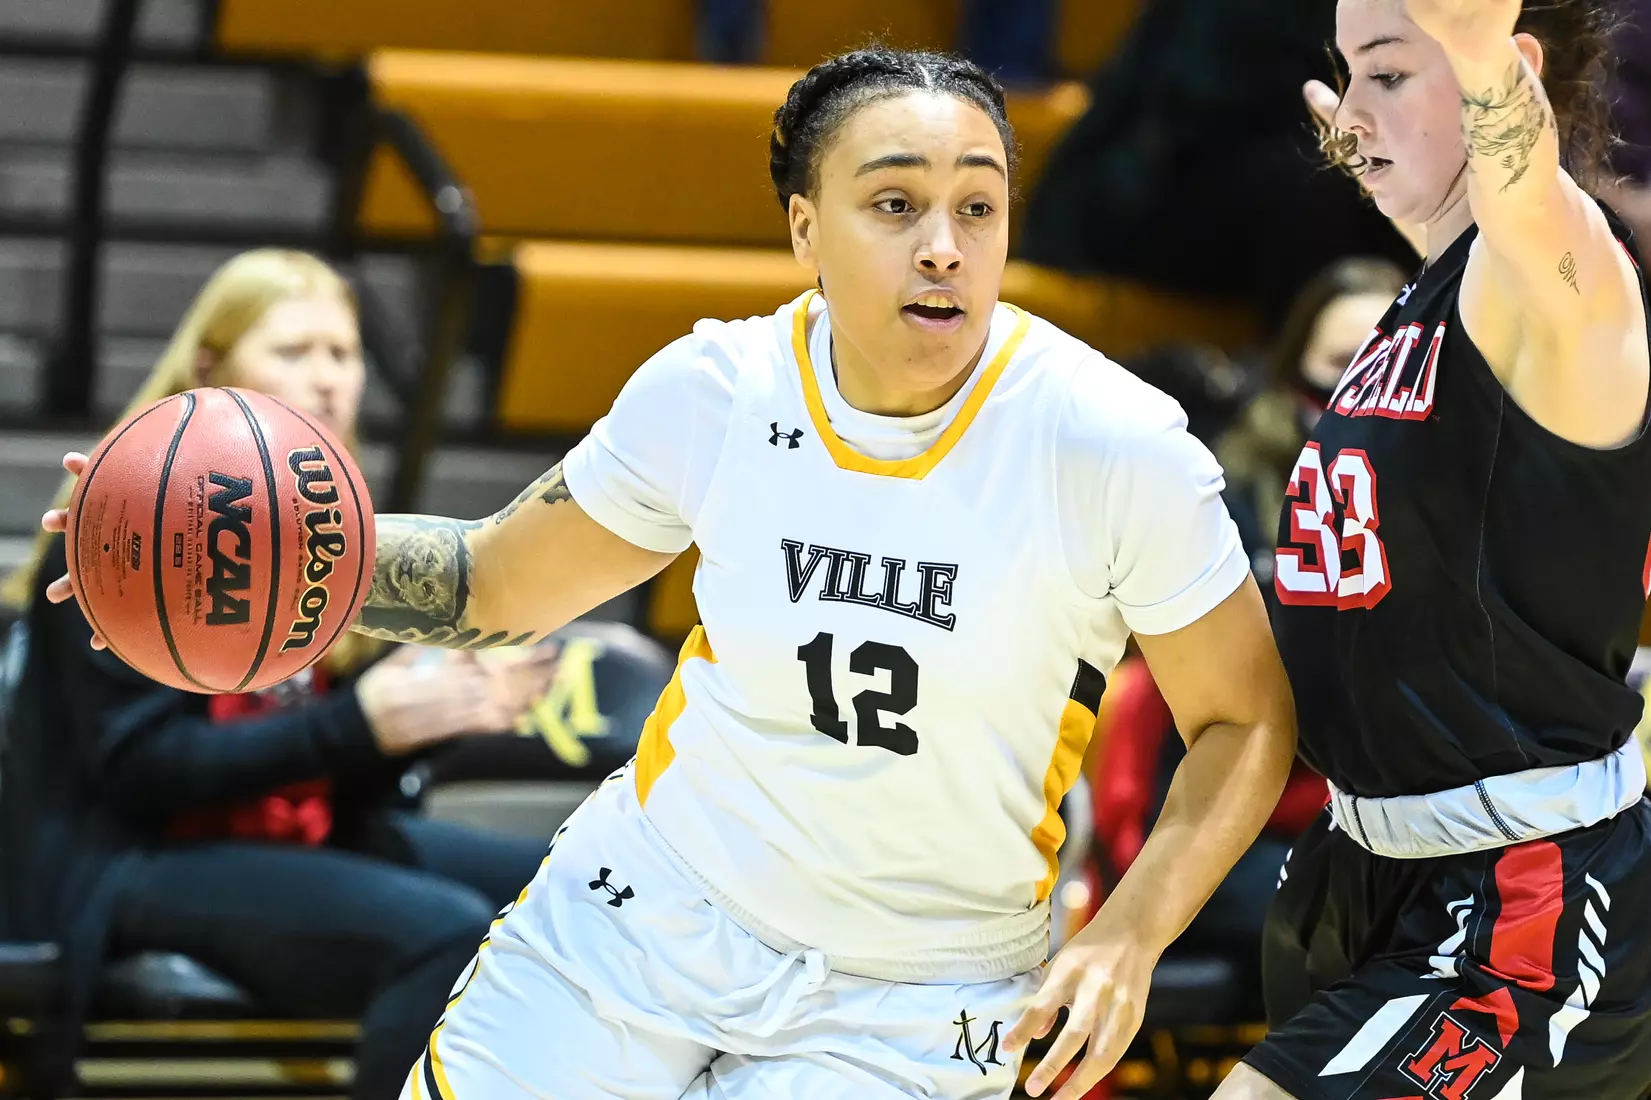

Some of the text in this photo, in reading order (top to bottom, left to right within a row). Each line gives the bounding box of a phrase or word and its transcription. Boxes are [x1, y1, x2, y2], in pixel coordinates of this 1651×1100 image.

[194, 475, 205, 625] OFFICIAL GAME BALL
[206, 471, 253, 625] NCAA
[280, 444, 347, 653] Wilson
[781, 538, 958, 632] VILLE
[1275, 440, 1392, 611] 33
[797, 632, 919, 756] 12
[1397, 1011, 1502, 1100] M
